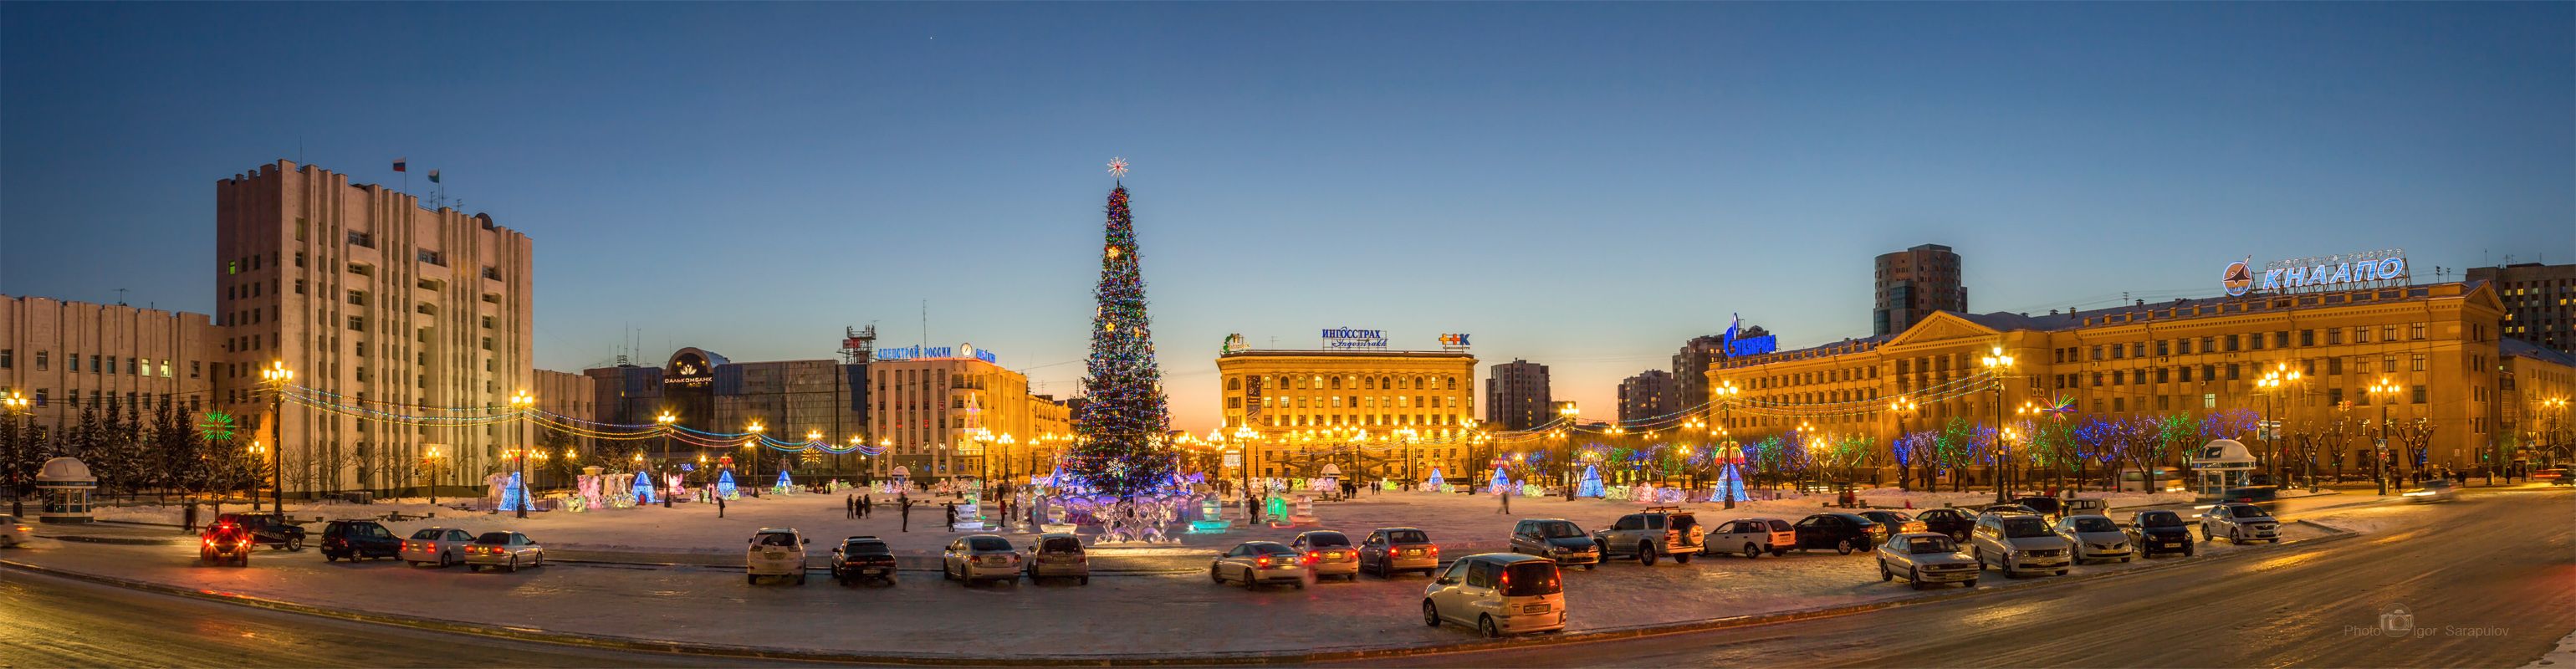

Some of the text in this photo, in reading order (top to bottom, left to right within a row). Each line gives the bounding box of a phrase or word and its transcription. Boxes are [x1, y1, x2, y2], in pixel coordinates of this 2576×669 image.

[2262, 257, 2404, 290] КНААПО
[1321, 326, 1381, 339] ИНГОССТРАХ
[878, 344, 952, 360] СПЕЦСТРОЙ РОССИИ
